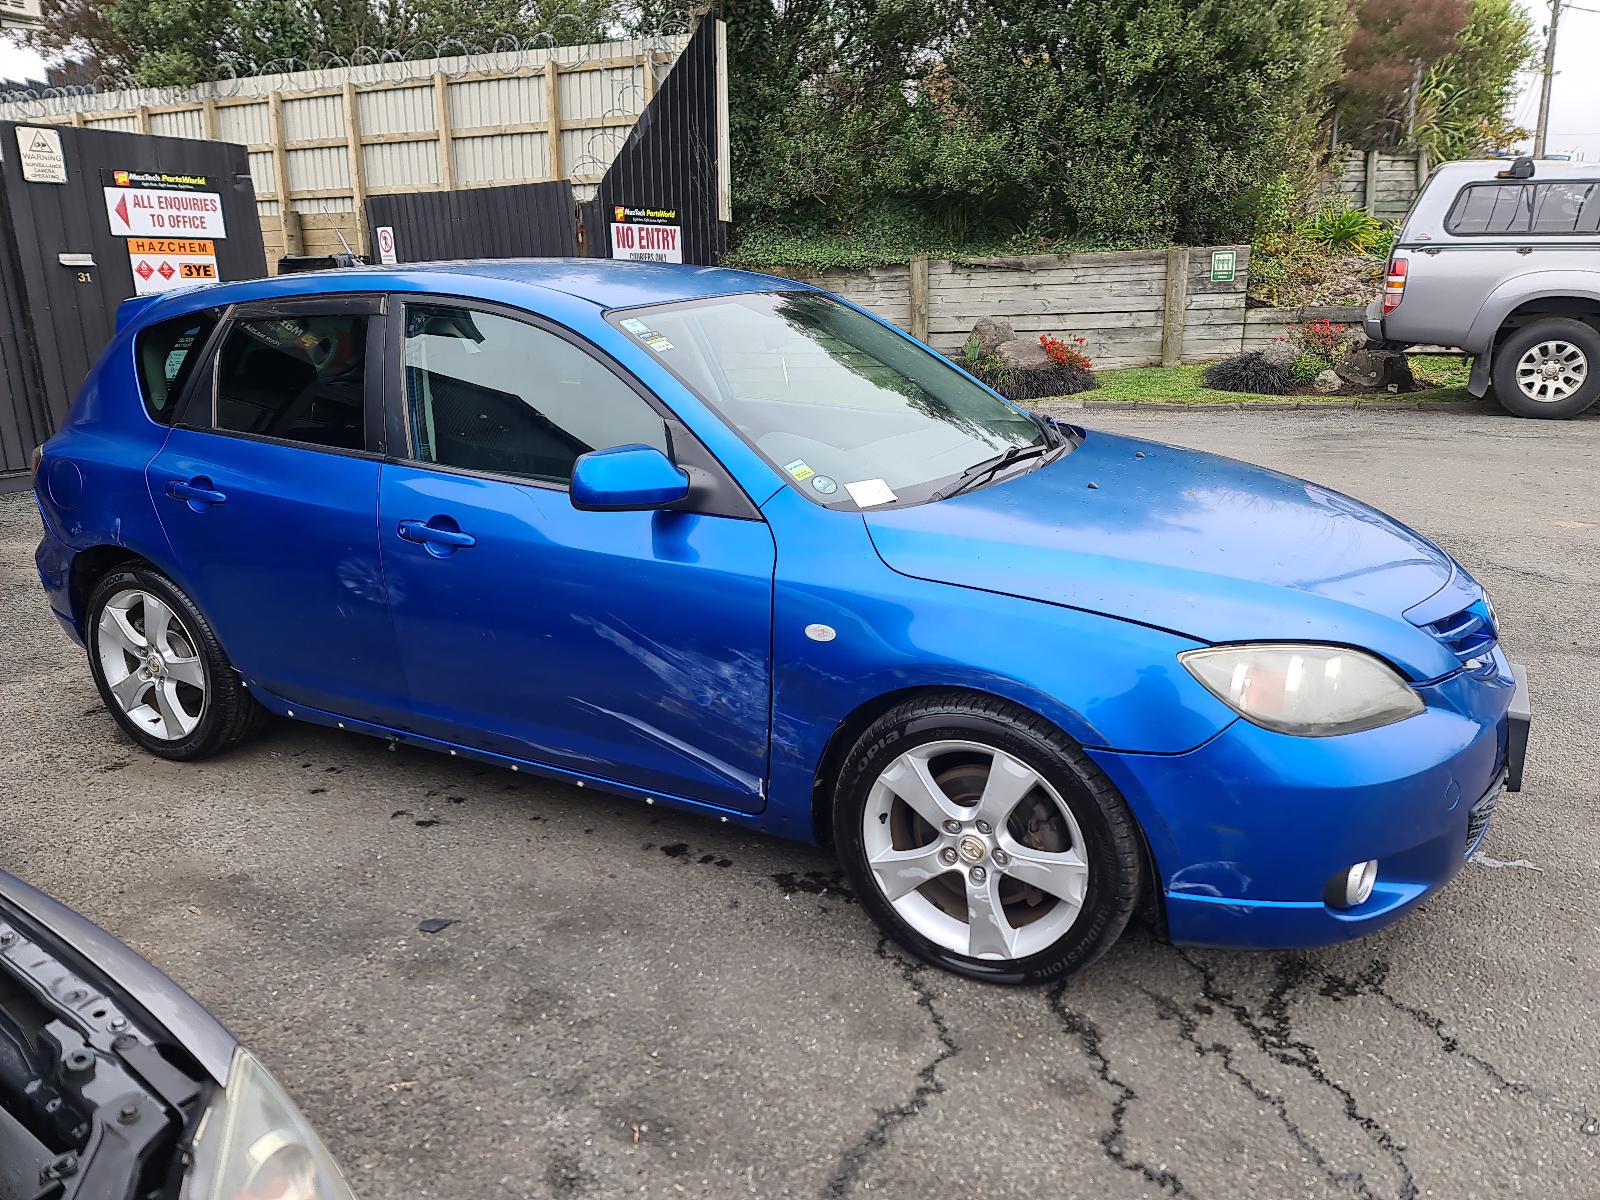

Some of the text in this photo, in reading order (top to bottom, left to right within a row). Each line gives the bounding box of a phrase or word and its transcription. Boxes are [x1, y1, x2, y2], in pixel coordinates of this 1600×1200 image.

[22, 153, 62, 161] WARNING
[161, 174, 207, 185] PartsWorld
[133, 194, 218, 213] ALL ENQUIRIES
[646, 209, 676, 219] PartsWorld
[149, 214, 207, 230] TO OFFICE
[616, 225, 677, 250] NO ENTRY
[136, 241, 208, 253] HAZCHEM
[183, 264, 212, 277] 3YE
[77, 272, 92, 283] 31
